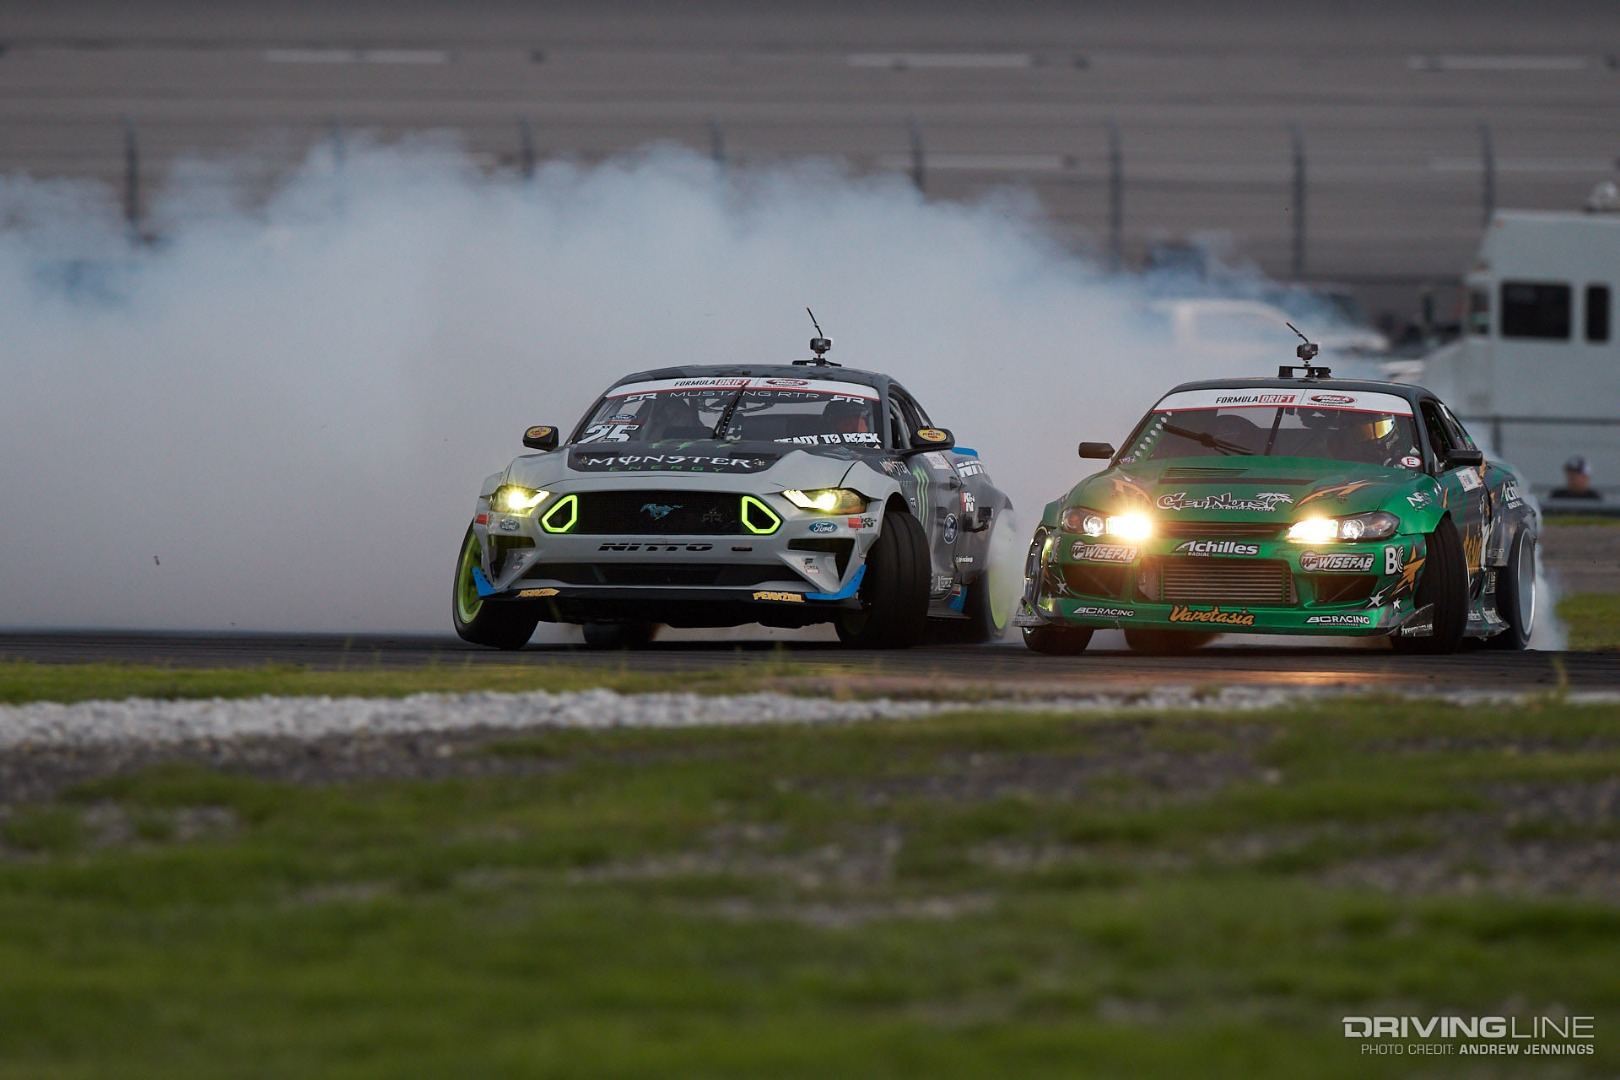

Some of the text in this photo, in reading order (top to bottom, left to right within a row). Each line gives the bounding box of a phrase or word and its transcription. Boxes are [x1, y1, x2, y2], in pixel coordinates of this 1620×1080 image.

[669, 390, 819, 400] MUSTANG RTR
[577, 424, 640, 443] 25
[774, 432, 882, 445] EADY TO ROCK
[587, 454, 752, 468] MONSTER
[609, 464, 723, 472] ENERGY
[598, 543, 713, 552] NITTO
[1084, 545, 1138, 560] WISEFAB
[1175, 541, 1258, 555] Achilles
[1318, 557, 1375, 569] WISEFAB
[1170, 606, 1255, 626] Vapetasia
